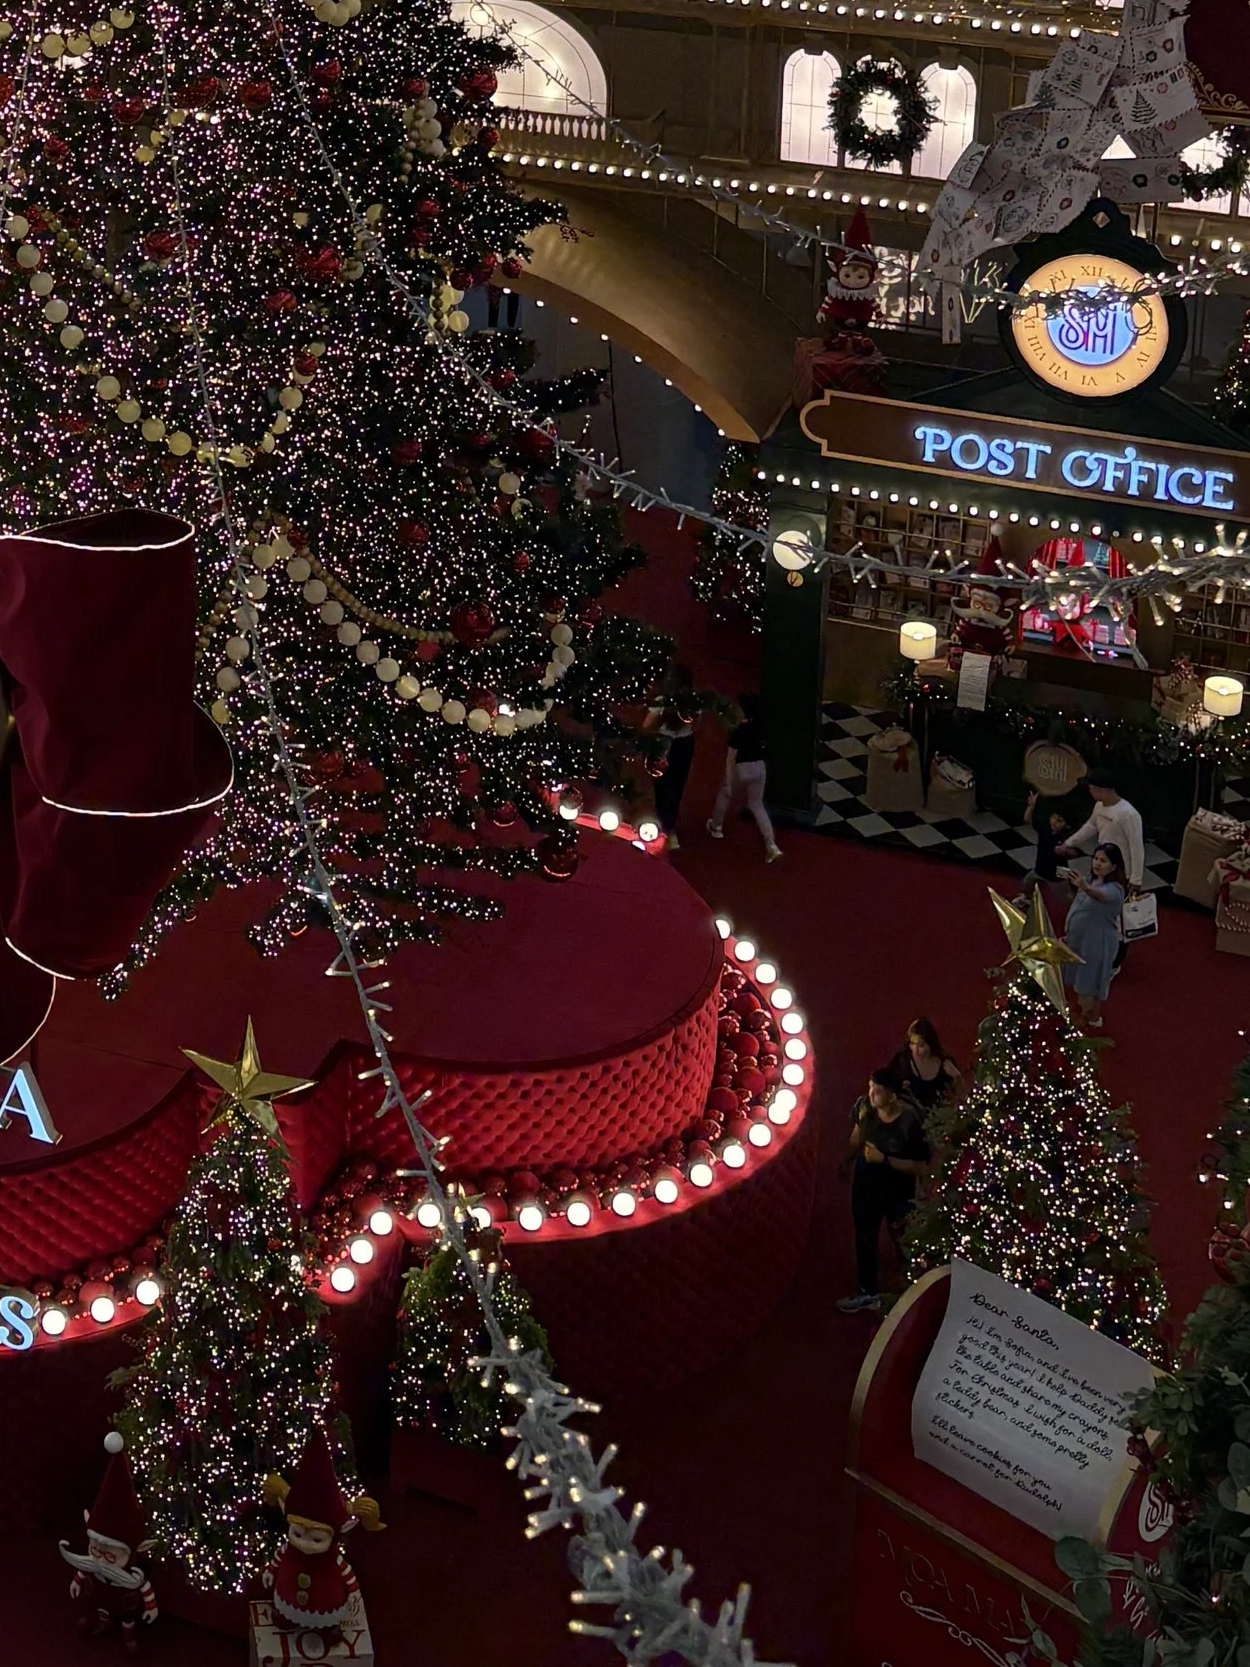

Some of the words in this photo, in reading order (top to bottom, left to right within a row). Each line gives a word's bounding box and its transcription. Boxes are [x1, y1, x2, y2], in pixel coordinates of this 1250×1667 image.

[1081, 265, 1103, 278] XII
[1027, 336, 1047, 361] VIII
[1049, 362, 1068, 380] VII
[1137, 351, 1150, 368] IV
[1081, 375, 1098, 386] VI
[1116, 372, 1126, 383] V
[915, 426, 1051, 479] POST
[1061, 446, 1235, 510] OFFICE
[1038, 754, 1068, 782] SM
[970, 1293, 1009, 1317] Dear
[1011, 1315, 1059, 1350] Santa,
[950, 1359, 968, 1375] For
[1033, 1411, 1057, 1429] wish
[1054, 1425, 1075, 1438] for
[1077, 1436, 1085, 1445] a
[958, 1334, 989, 1351] good
[989, 1345, 1006, 1364] this
[1046, 1377, 1067, 1398] help
[1069, 1394, 1107, 1423] Daddy
[973, 1354, 1000, 1376] table
[1000, 1373, 1024, 1389] and
[1020, 1385, 1051, 1405] share
[1051, 1402, 1066, 1418] my
[1037, 1358, 1059, 1374] and
[1080, 1380, 1102, 1398] been
[1103, 1395, 1126, 1415] very
[943, 1378, 951, 1386] a
[952, 1380, 981, 1408] teddy
[1010, 1417, 1033, 1433] and
[1031, 1429, 1057, 1448] some
[1054, 1445, 1089, 1470] pretty
[950, 1425, 976, 1447] leave
[976, 1444, 1012, 1469] cookies
[1012, 1464, 1031, 1478] for
[1031, 1477, 1051, 1490] you
